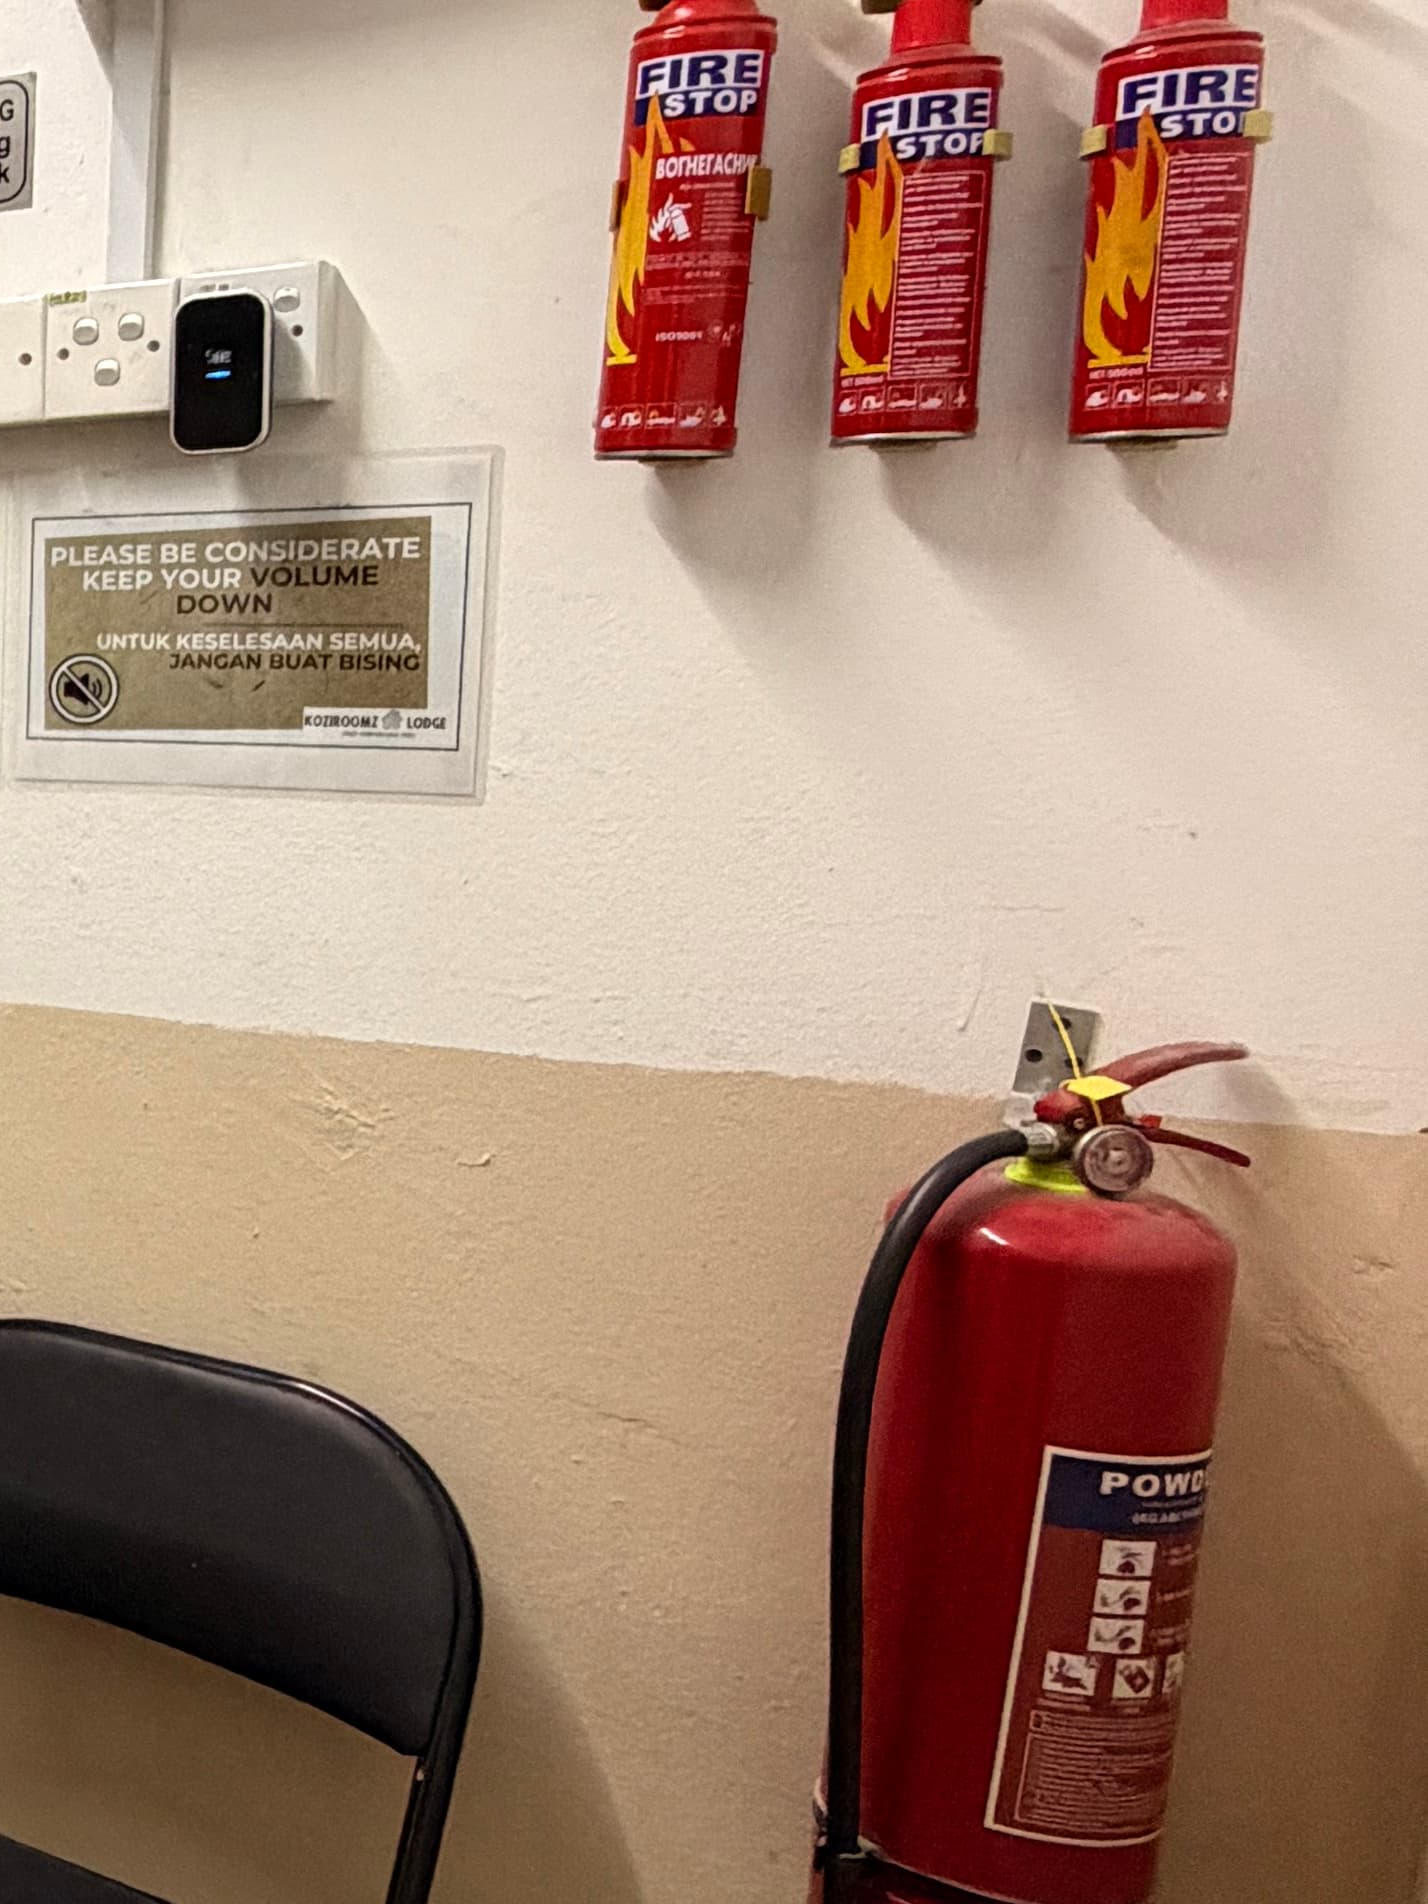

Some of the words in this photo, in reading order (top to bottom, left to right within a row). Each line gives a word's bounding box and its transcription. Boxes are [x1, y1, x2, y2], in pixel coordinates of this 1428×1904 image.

[639, 54, 761, 96] FIRE
[664, 89, 758, 118] STOP
[1123, 68, 1257, 114] FIRE
[866, 92, 990, 137] FIRE
[1160, 110, 1244, 139] STO
[50, 543, 152, 567] PLEASE
[159, 542, 197, 564] BE
[204, 536, 421, 563] CONSIDERATE
[82, 568, 153, 592] KEEP
[160, 567, 242, 589] YOUR
[250, 565, 379, 588] VOLUME
[176, 592, 273, 615] DOWN
[96, 632, 172, 651] UNTUK
[176, 632, 323, 651] KESELESAAN
[328, 631, 422, 654] SEMUA,
[169, 652, 262, 671] JANGAN
[269, 653, 333, 671] BUAT
[339, 653, 421, 672] BISING
[304, 714, 378, 729] KOZIROOMZ
[407, 716, 447, 730] LODGE
[1099, 1468, 1207, 1497] POWD
